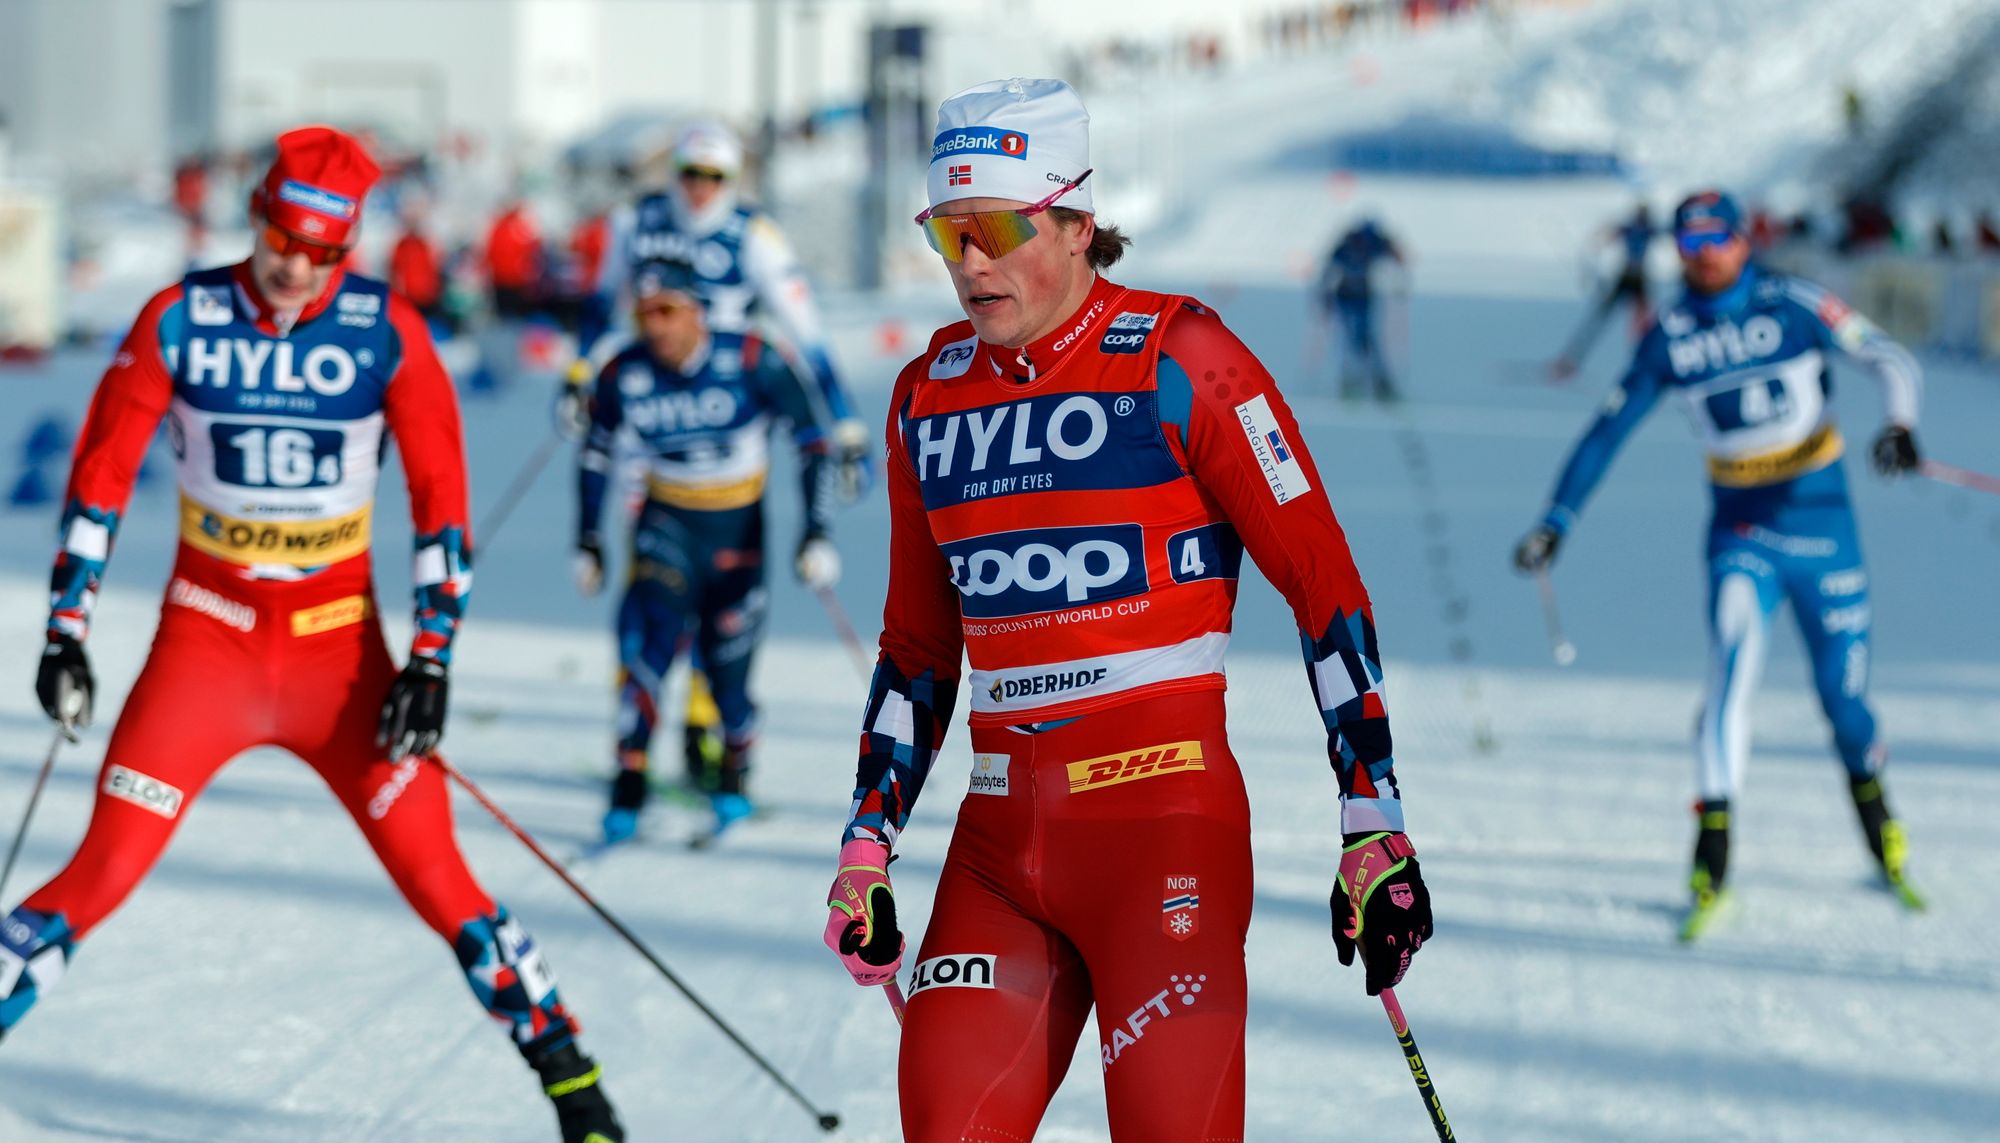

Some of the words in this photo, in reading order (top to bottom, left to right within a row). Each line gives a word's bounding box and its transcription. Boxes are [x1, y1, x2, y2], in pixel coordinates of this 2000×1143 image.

[931, 134, 998, 156] pareBank
[1008, 137, 1018, 151] 1
[1046, 172, 1073, 186] CRAF
[1053, 308, 1096, 352] CRAFT
[1104, 334, 1145, 347] coop
[186, 337, 357, 397] HYLO
[230, 427, 316, 488] 16
[918, 396, 1108, 481] HYLO
[1239, 405, 1288, 503] TORGHATTEN
[963, 483, 987, 499] FOR
[992, 477, 1017, 494] DRY
[1022, 472, 1053, 489] EYES
[950, 540, 1130, 602] coop
[1181, 536, 1206, 576] 4
[989, 616, 1052, 635] COUNTRY
[1055, 606, 1113, 625] WORLD
[1117, 600, 1150, 616] CUP
[1004, 668, 1107, 698] OBERHOF
[1087, 747, 1189, 785] DHL
[840, 876, 866, 913] LEKI
[1167, 877, 1197, 889] NOR
[1352, 852, 1375, 905] LEK
[1102, 988, 1171, 1073] RAFT
